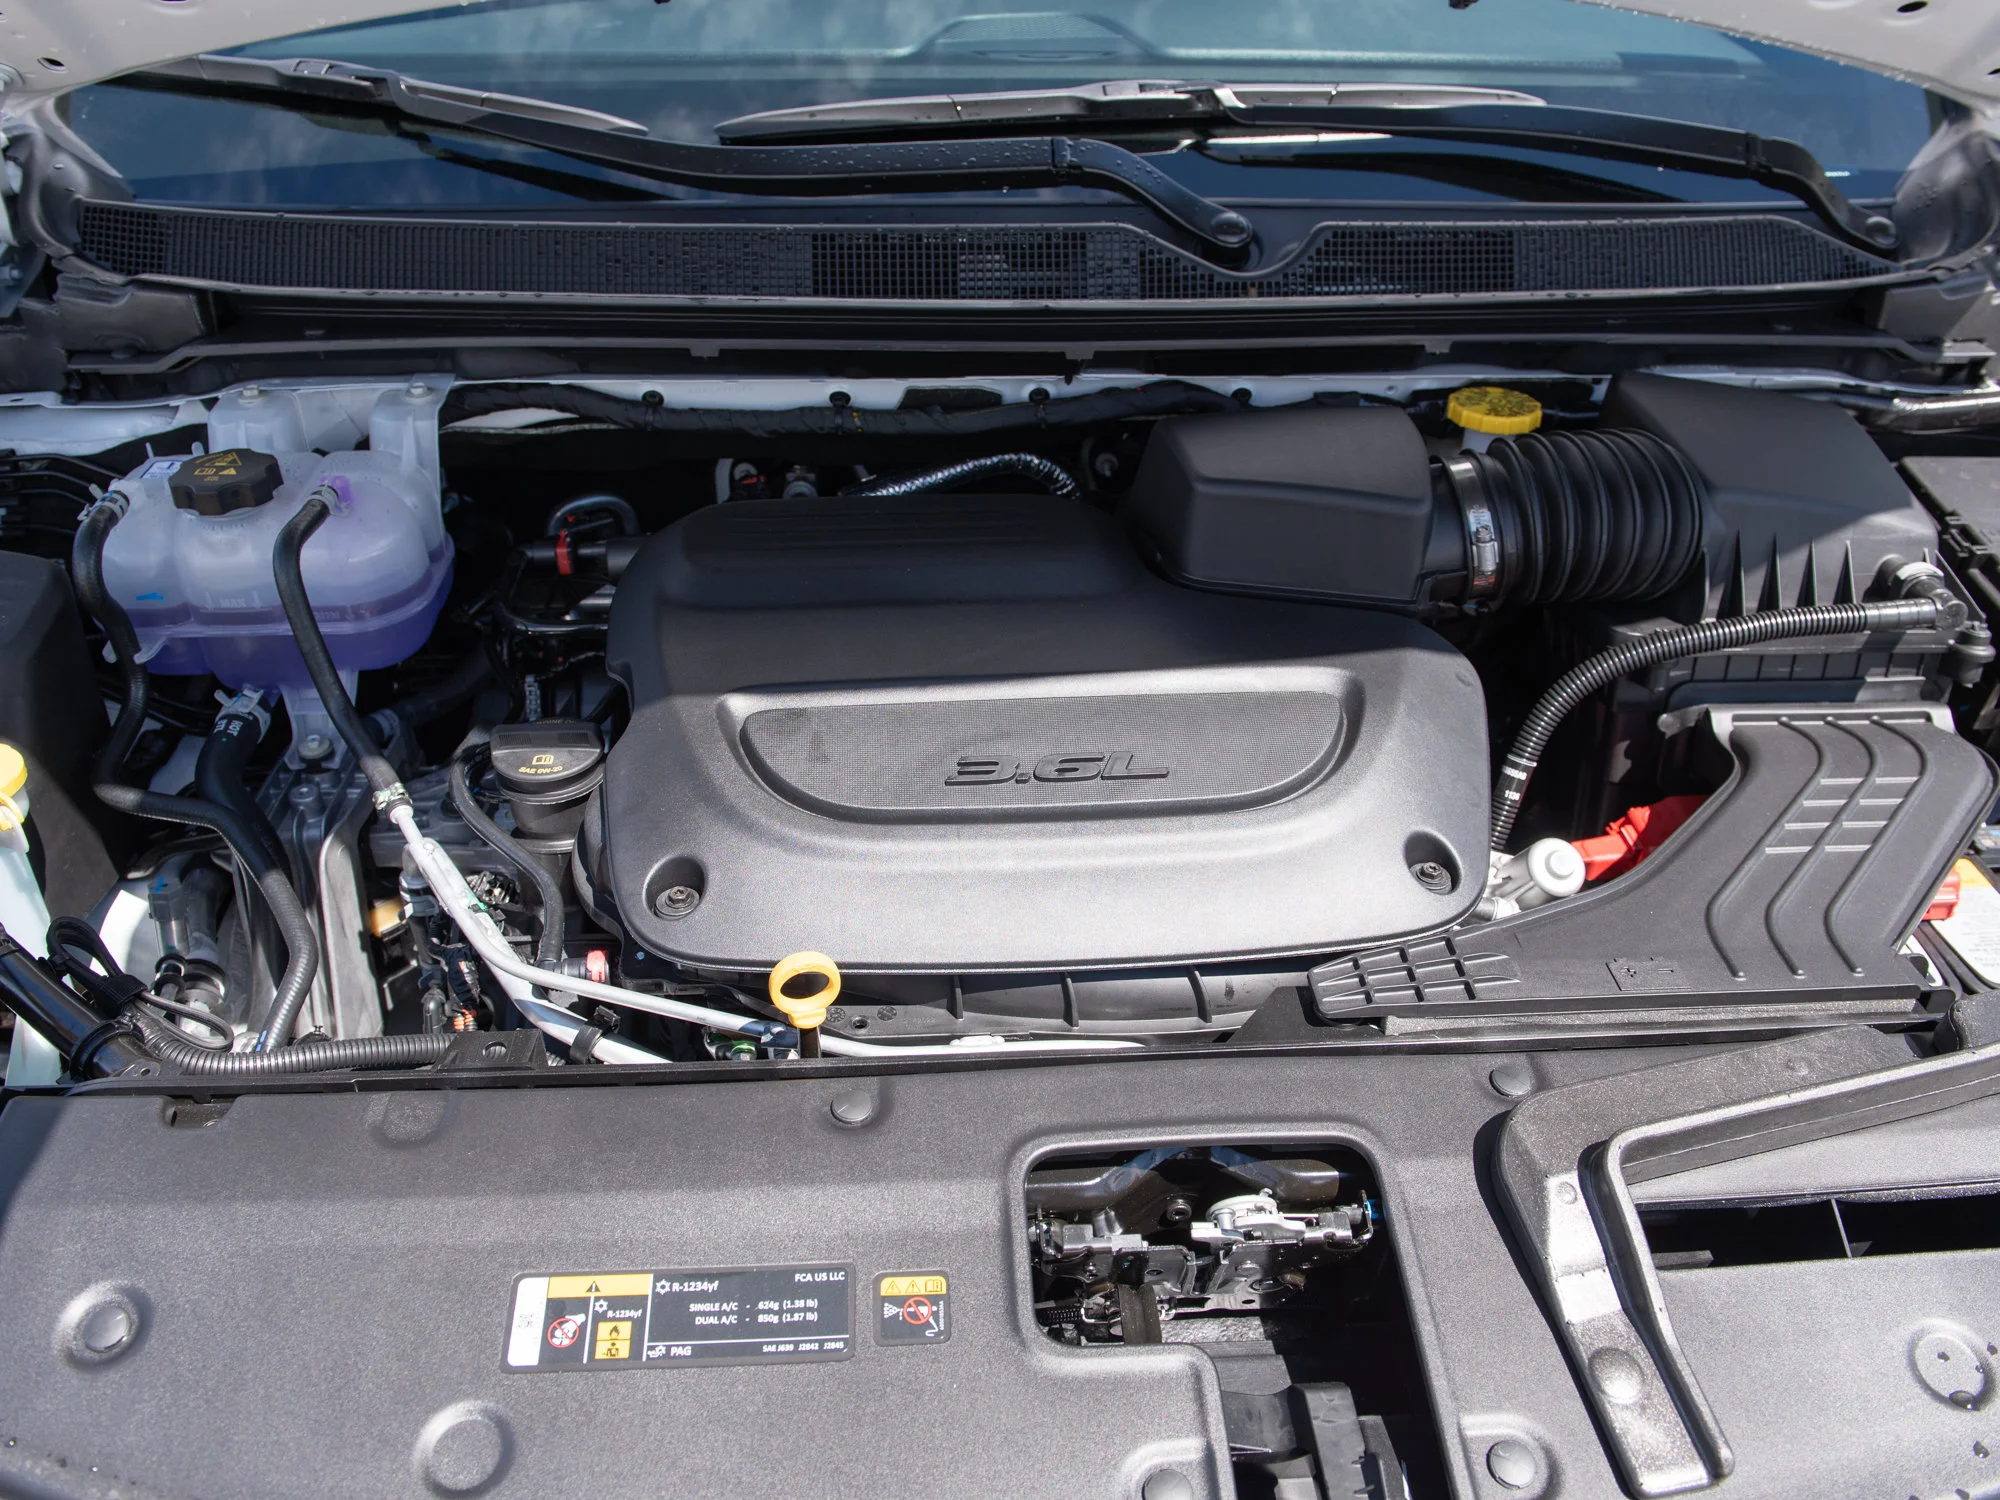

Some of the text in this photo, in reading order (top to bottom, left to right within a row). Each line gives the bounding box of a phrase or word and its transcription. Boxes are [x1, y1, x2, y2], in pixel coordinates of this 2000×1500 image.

[227, 720, 243, 736] HOT
[518, 766, 536, 774] SAE
[944, 750, 1170, 787] 3.6L
[795, 1271, 845, 1282] FCA US LLC
[672, 1281, 719, 1293] R-1234yf
[689, 1303, 720, 1312] SINGLE
[721, 1302, 738, 1312] A/C
[758, 1300, 780, 1311] 624g
[783, 1299, 805, 1310] (1.38
[806, 1298, 818, 1309] lb)
[607, 1308, 642, 1319] R-1234yf
[695, 1316, 719, 1325] DUAL
[720, 1315, 738, 1325] A/C
[757, 1314, 779, 1324] 850g
[782, 1312, 805, 1323] (1.87
[805, 1311, 818, 1322] lb)
[670, 1346, 692, 1356] PAG
[762, 1344, 777, 1352] SAE
